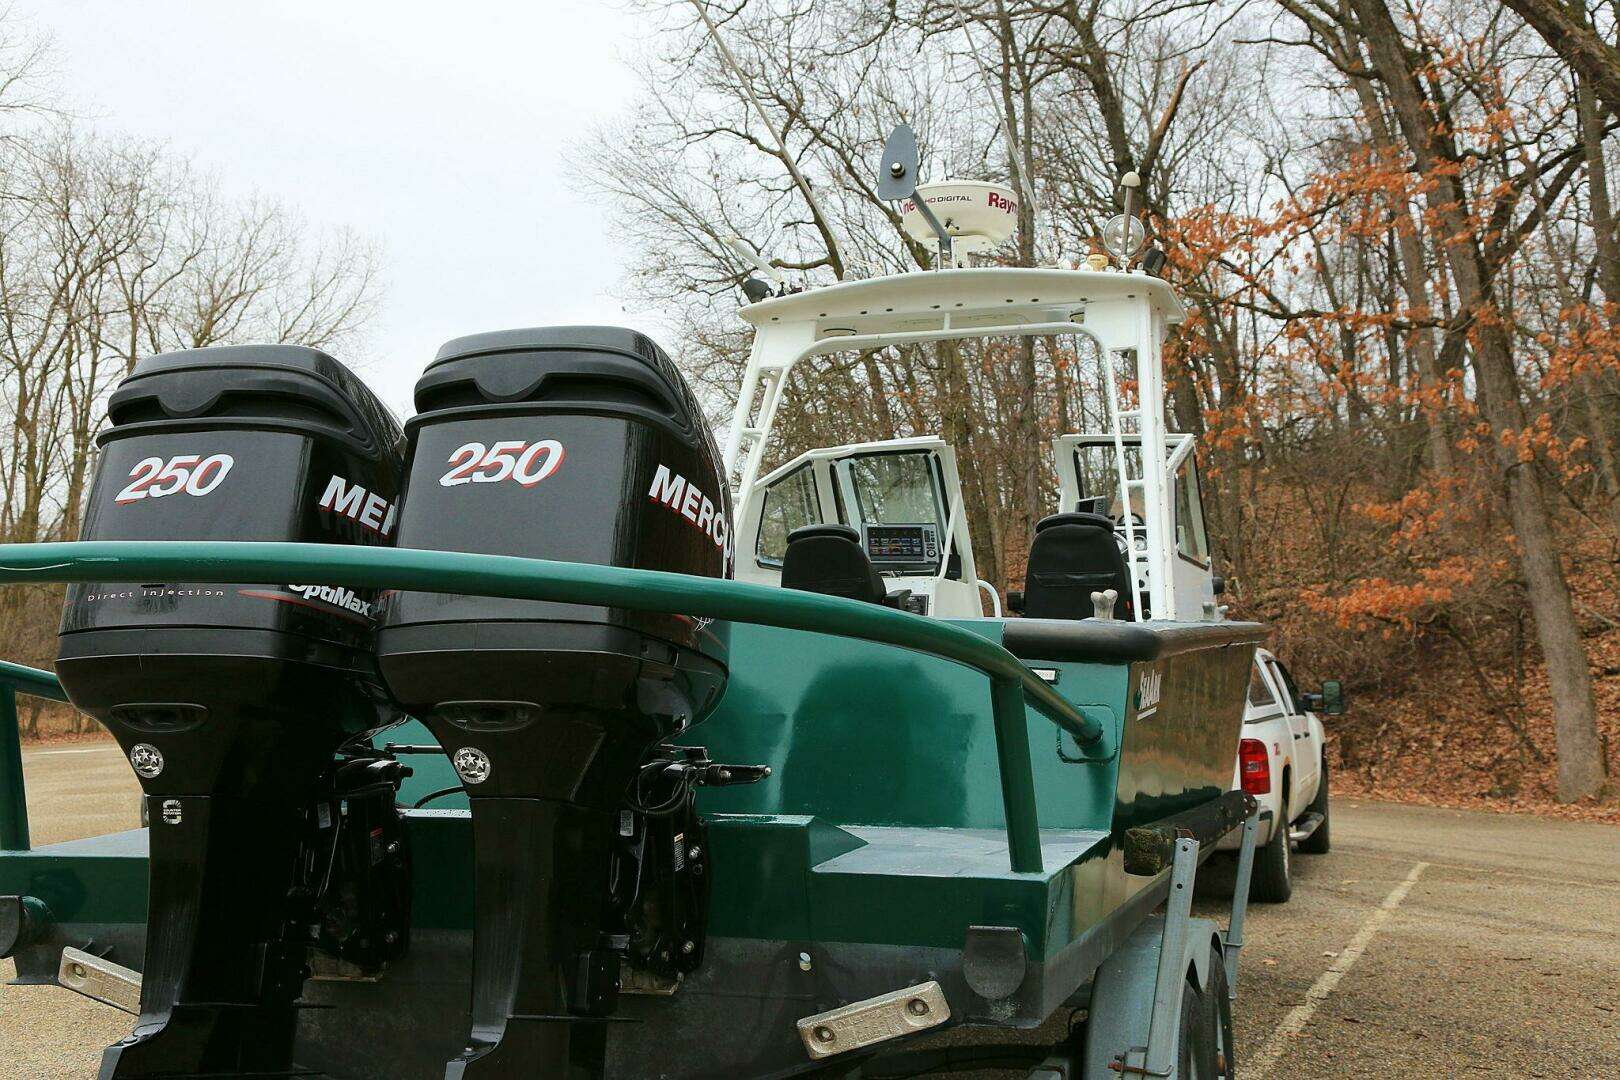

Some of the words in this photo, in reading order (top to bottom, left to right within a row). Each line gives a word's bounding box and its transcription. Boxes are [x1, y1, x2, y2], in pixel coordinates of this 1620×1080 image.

[937, 195, 972, 203] DIGITAL
[113, 454, 235, 505] 250
[438, 439, 567, 489] 250
[87, 591, 133, 602] Direct
[142, 588, 224, 598] Injection
